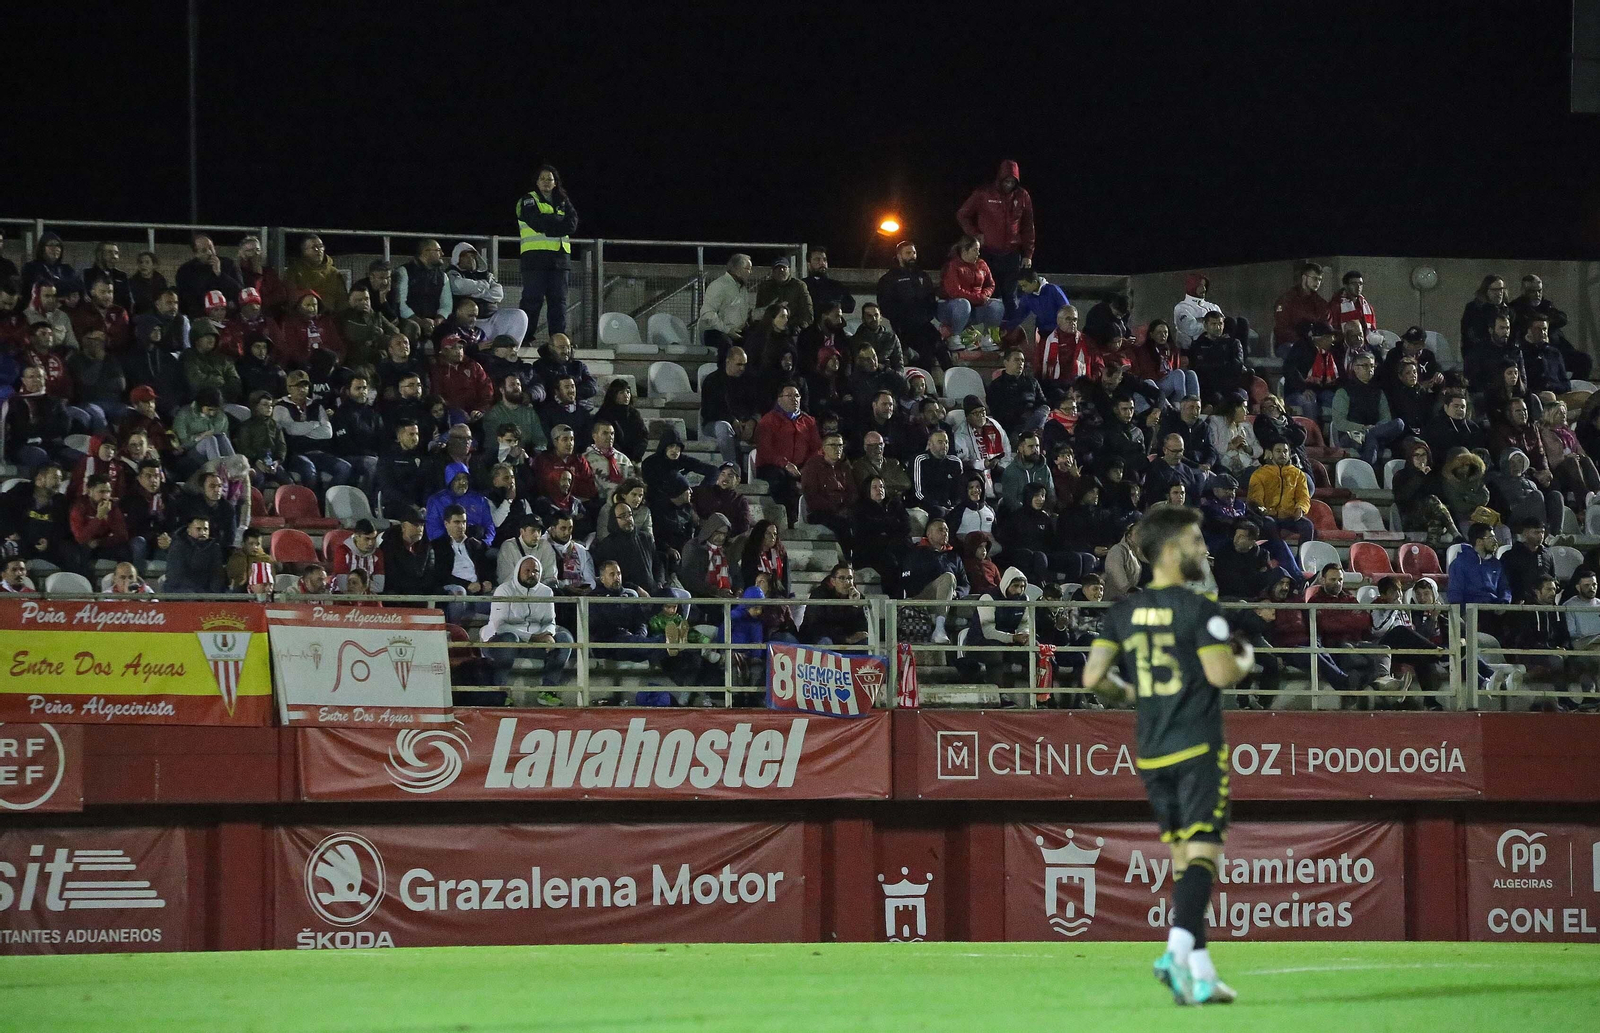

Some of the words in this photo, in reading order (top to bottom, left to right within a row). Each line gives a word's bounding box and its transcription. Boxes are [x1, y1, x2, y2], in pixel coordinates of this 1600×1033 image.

[21, 601, 67, 625] Peña
[72, 604, 166, 630] Algecirista
[312, 606, 340, 622] Peña
[343, 608, 403, 626] Algecirista
[9, 650, 65, 677] Entre
[74, 651, 114, 676] Dos
[121, 652, 187, 683] Aguas
[772, 653, 794, 700] 8
[796, 663, 852, 687] SIEMPRE
[1122, 631, 1183, 698] 15
[802, 684, 832, 701] CAPI
[27, 694, 75, 715] Peña
[81, 696, 176, 721] Algecirista
[318, 707, 349, 723] Entre
[353, 708, 374, 723] Dos
[377, 708, 415, 725] Aguas
[484, 717, 809, 789] Lavahostel
[987, 736, 1137, 776] CLÍNICA
[1308, 740, 1467, 773] PODOLOGÍA
[1124, 848, 1375, 894] Aytamiento
[1493, 878, 1553, 889] ALGECIRAS
[399, 866, 637, 912] Grazalema
[652, 863, 784, 906] Motor
[1487, 907, 1554, 934] CON
[1563, 908, 1597, 933] EL
[65, 928, 162, 943] ADUANEROS
[296, 928, 396, 950] ŠKODA
